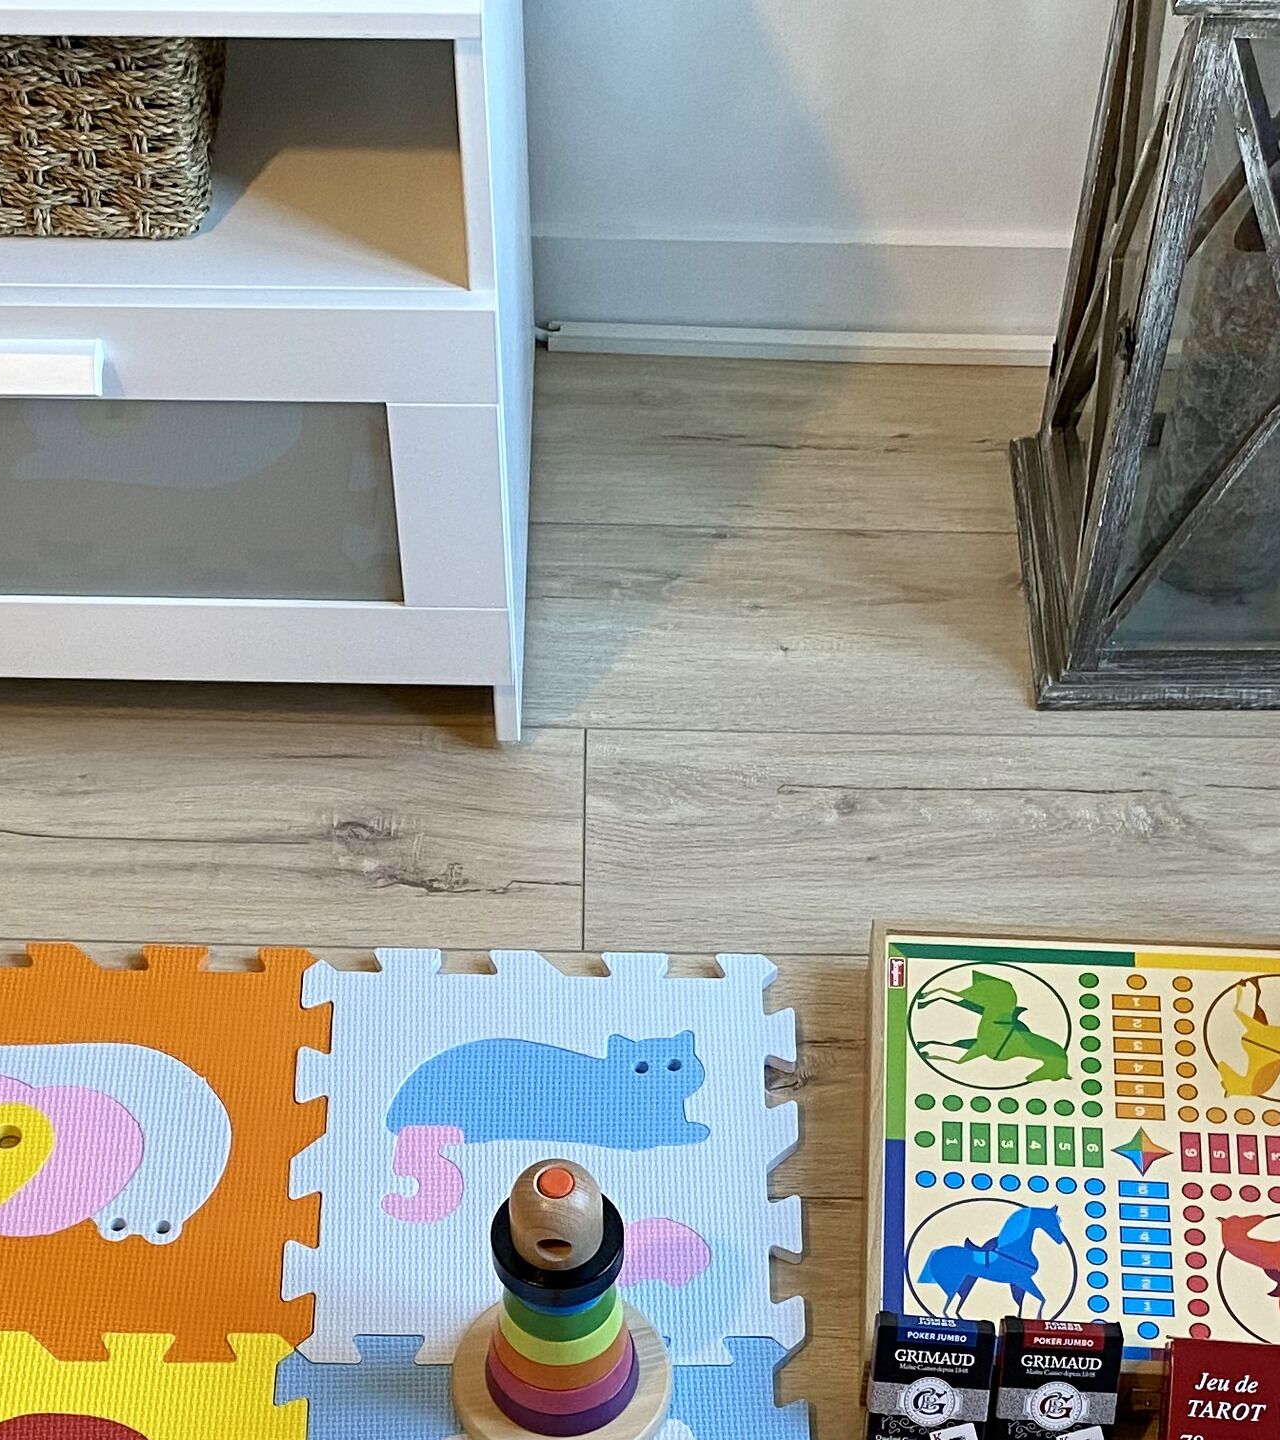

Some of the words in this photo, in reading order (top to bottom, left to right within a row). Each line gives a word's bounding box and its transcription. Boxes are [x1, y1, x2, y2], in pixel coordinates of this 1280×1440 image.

[945, 1137, 959, 1146] 1
[973, 1138, 986, 1148] 2
[1001, 1139, 1014, 1149] 3
[1029, 1140, 1042, 1150] 4
[1058, 1142, 1071, 1151] 5
[1086, 1143, 1100, 1153] 6
[1185, 1147, 1198, 1158] 6
[1213, 1150, 1226, 1159] 5
[1243, 1150, 1256, 1161] 4
[380, 1124, 464, 1223] 5
[907, 1331, 936, 1340] POKER
[937, 1334, 967, 1343] JUMBO
[1033, 1336, 1062, 1346] POKER
[1063, 1339, 1095, 1348] JUMBO
[894, 1348, 975, 1367] GRIMAUD
[1021, 1354, 1103, 1371] GRIMAUD
[1194, 1371, 1230, 1393] Jeu
[1234, 1374, 1259, 1394] de
[1187, 1399, 1266, 1422] TAROT
